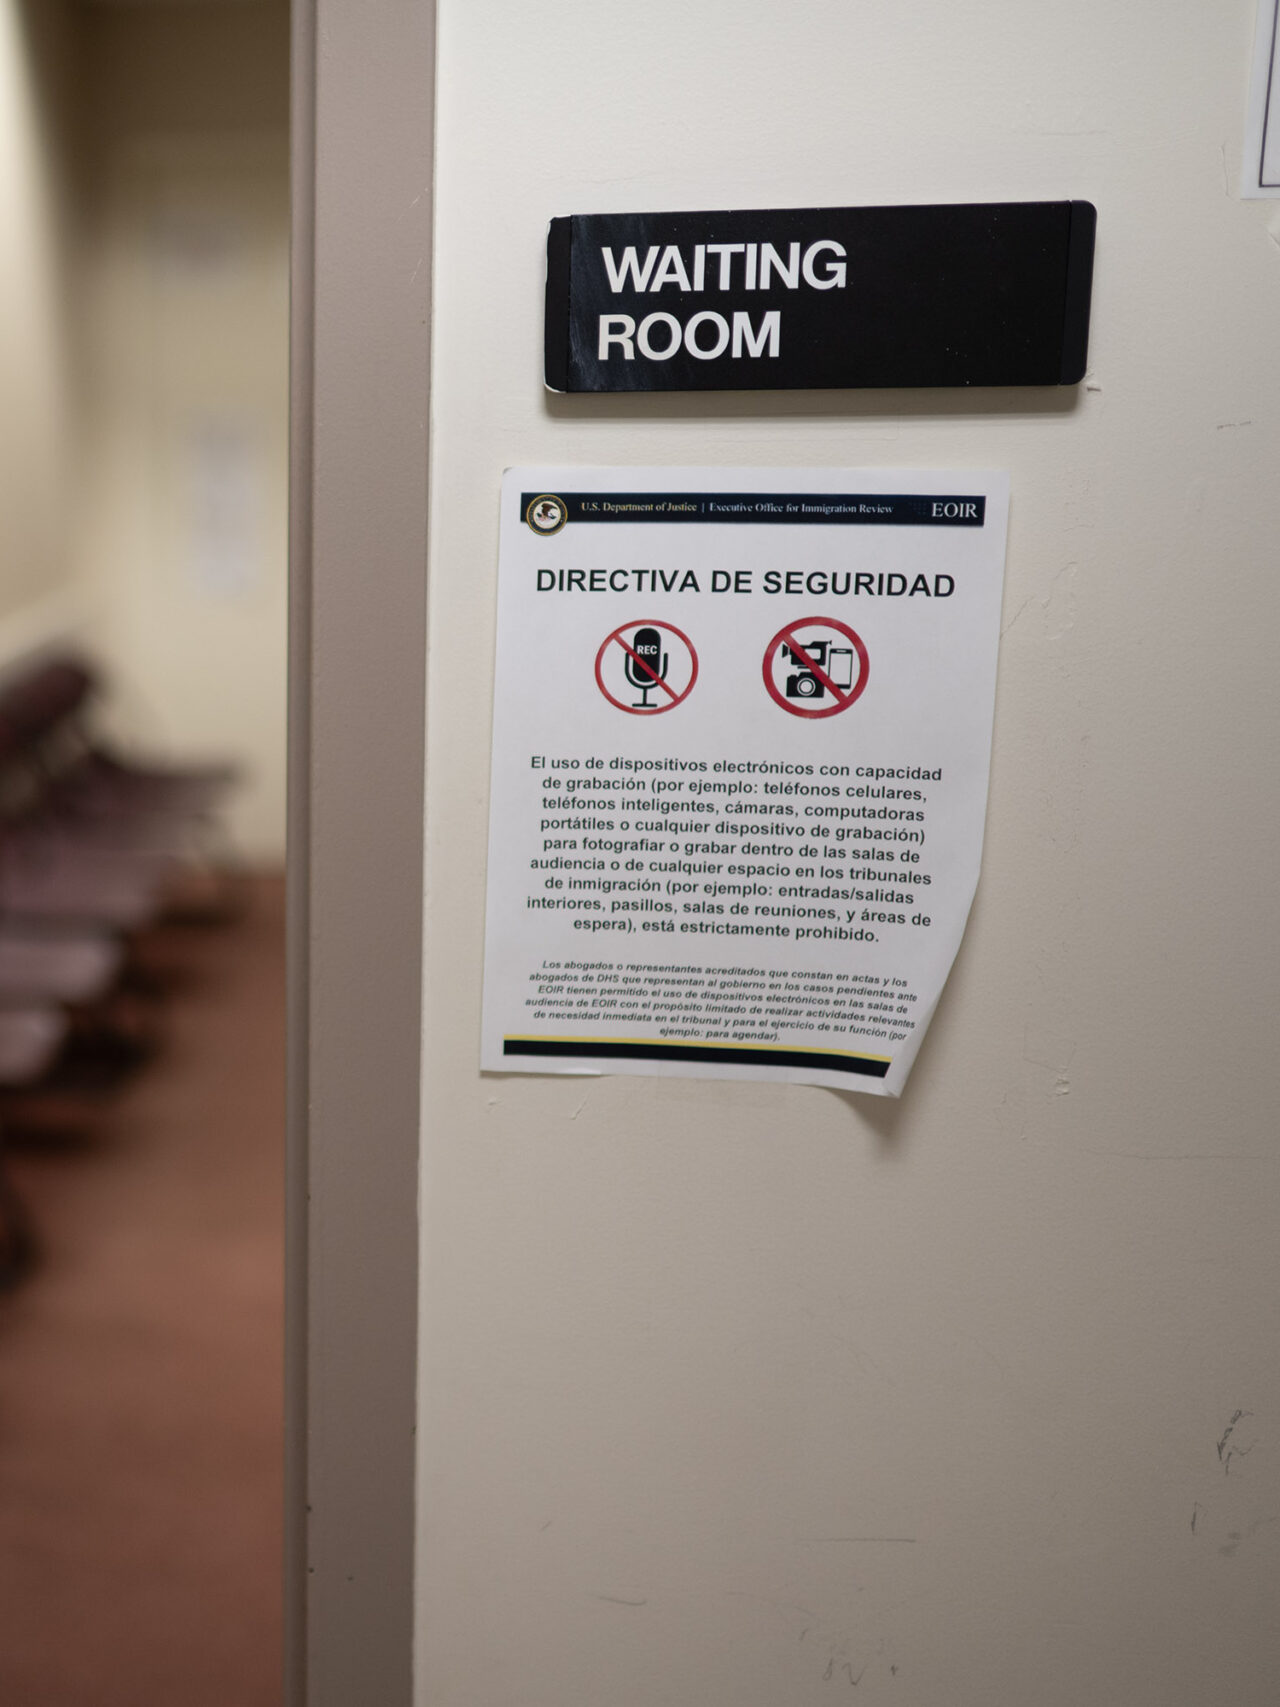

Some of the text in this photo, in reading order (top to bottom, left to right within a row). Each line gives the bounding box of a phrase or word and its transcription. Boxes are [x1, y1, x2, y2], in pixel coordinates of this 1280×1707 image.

[602, 240, 847, 292] WAITING
[598, 311, 781, 360] ROOM
[581, 502, 892, 515] U.S. Department of Justice Executive Office for Immigration Review
[932, 502, 978, 518] EOIR
[537, 569, 955, 597] DIRECTIVA DE SEGURIDAD
[637, 645, 658, 655] REC
[531, 756, 942, 781] El uso de dispositivos electrónicos con capacidad
[542, 776, 926, 803] de grabación (por ejemplo: teléfonos celulares,
[542, 796, 925, 822] teléfonos inteligentes, cámaras, computadoras
[541, 816, 925, 846] portátiles o cualquier dispositivo de grabación)
[543, 837, 920, 863] para fotografiar o grabar dentro de las salas de
[530, 857, 931, 885] audiencia o de cualquier espacio en los tribunales
[545, 876, 914, 904] de inmigración (por ejemplo: entradas/salidas
[527, 896, 931, 927] interiores, pasillos, salas de reuniones, y áreas de
[573, 918, 879, 942] espera), está estrictamente prohibido.
[529, 972, 579, 983] abogados
[581, 973, 594, 982] de
[597, 974, 619, 983] DHS
[622, 976, 641, 985] que
[643, 977, 705, 987] representan
[707, 979, 717, 987] al
[719, 980, 766, 990] gobierno
[784, 982, 800, 991] los
[803, 984, 834, 993] casos
[836, 987, 895, 999] pendientes
[897, 993, 917, 1002] ante
[542, 960, 561, 969] Los
[564, 961, 613, 972] abogados
[626, 964, 702, 974] representantes
[705, 967, 766, 977] acreditados
[769, 970, 789, 979] que
[791, 971, 833, 980] constan
[852, 975, 880, 984] actas
[882, 978, 890, 987] y
[891, 977, 907, 987] los
[525, 997, 915, 1029] audiencia de EOIR con el propósito limitado de realizar actividades relevantes
[538, 985, 564, 994] EOIR
[566, 986, 597, 995] tienen
[599, 987, 649, 997] permitido
[651, 989, 661, 997] el
[685, 990, 698, 999] de
[700, 990, 763, 1002] dispositivos
[766, 994, 830, 1006] electrónicos
[833, 999, 846, 1007] en
[849, 999, 864, 1008] las
[867, 1002, 894, 1012] salas
[896, 1005, 908, 1014] de
[533, 1010, 546, 1019] de
[548, 1011, 601, 1020] necesidad
[602, 1011, 652, 1022] inmediata
[670, 1014, 680, 1023] el
[682, 1015, 722, 1025] tribunal
[723, 1019, 731, 1028] y
[732, 1019, 756, 1028] para
[758, 1019, 768, 1027] el
[770, 1019, 815, 1030] ejercicio
[817, 1022, 831, 1031] de
[849, 1024, 887, 1038] función
[889, 1030, 907, 1041] (por
[659, 1027, 780, 1042] ejemplo: para agendar).
